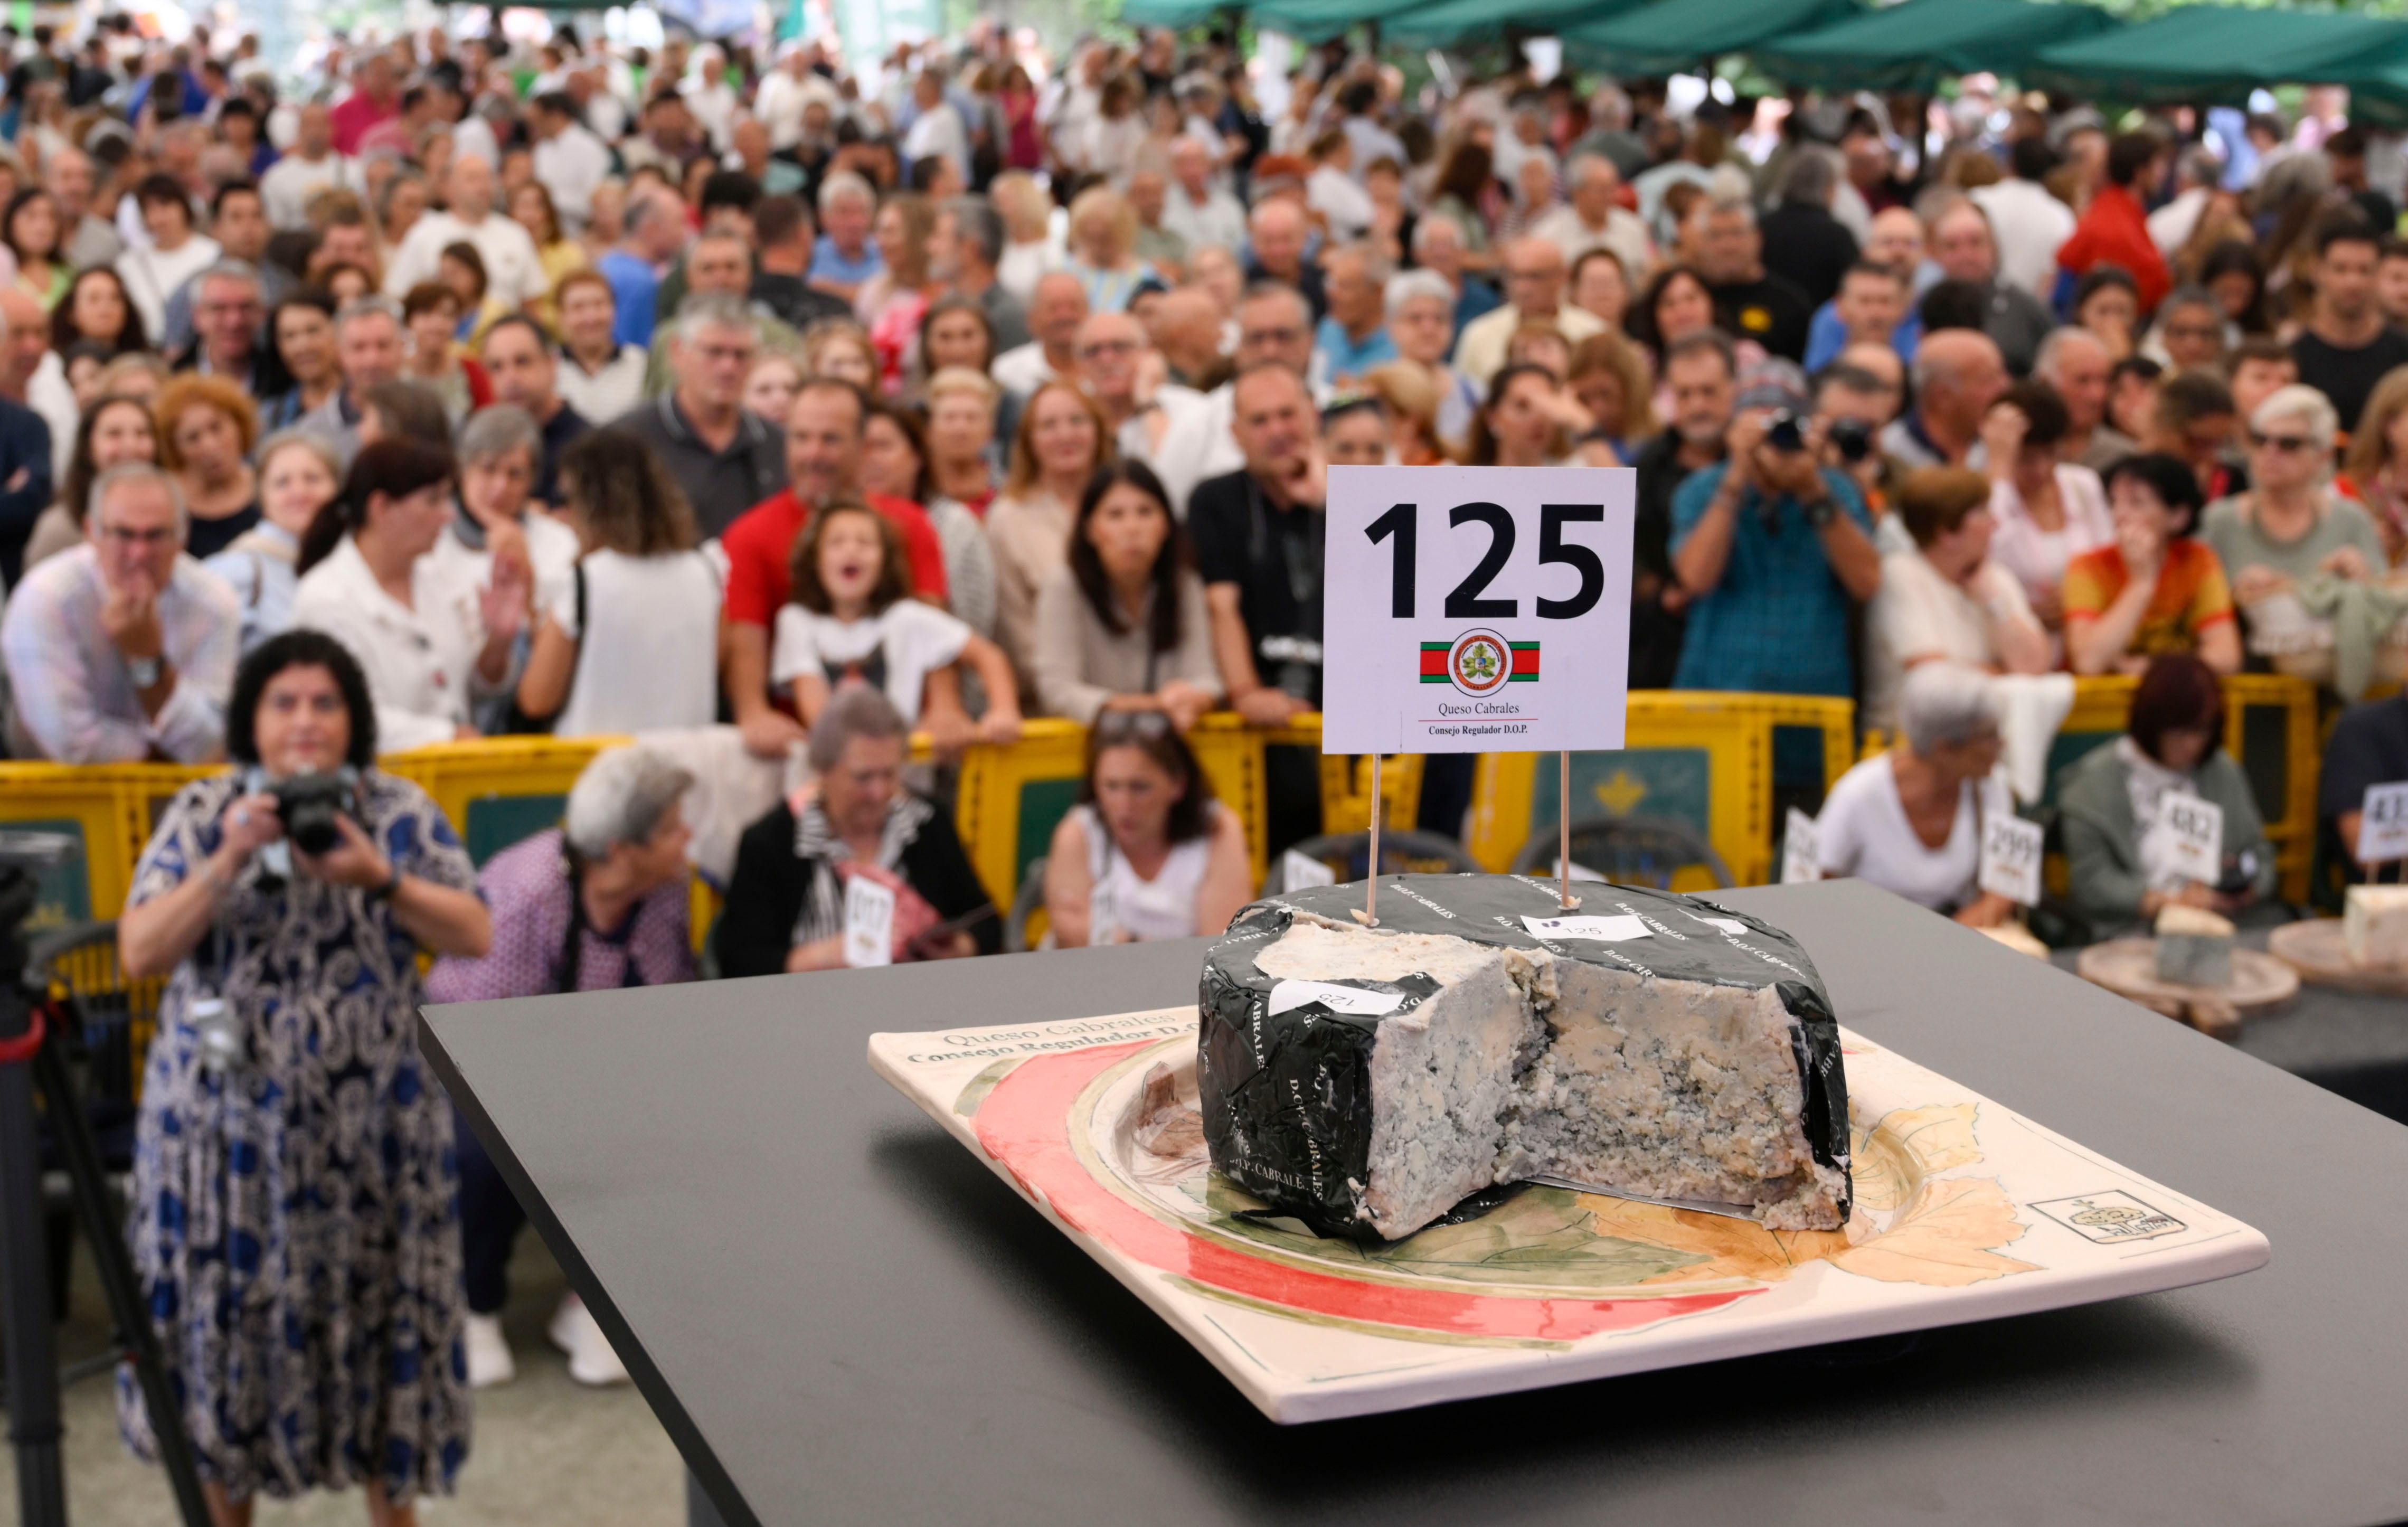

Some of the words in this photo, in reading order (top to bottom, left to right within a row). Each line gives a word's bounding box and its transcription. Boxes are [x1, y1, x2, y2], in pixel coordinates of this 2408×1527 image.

[1364, 501, 1604, 619] 125
[1439, 703, 1471, 717] Queso
[1475, 702, 1519, 714] Cabrales
[1429, 725, 1460, 736] Consejo
[1462, 725, 1502, 736] Regulador
[1504, 724, 1528, 733] D.O.P.
[1411, 894, 1457, 919] CABRALES
[943, 1031, 1040, 1046] Queso
[1046, 1015, 1176, 1035] Cabrales
[907, 1047, 1014, 1063] Consejo
[1016, 1030, 1153, 1051] Regulador
